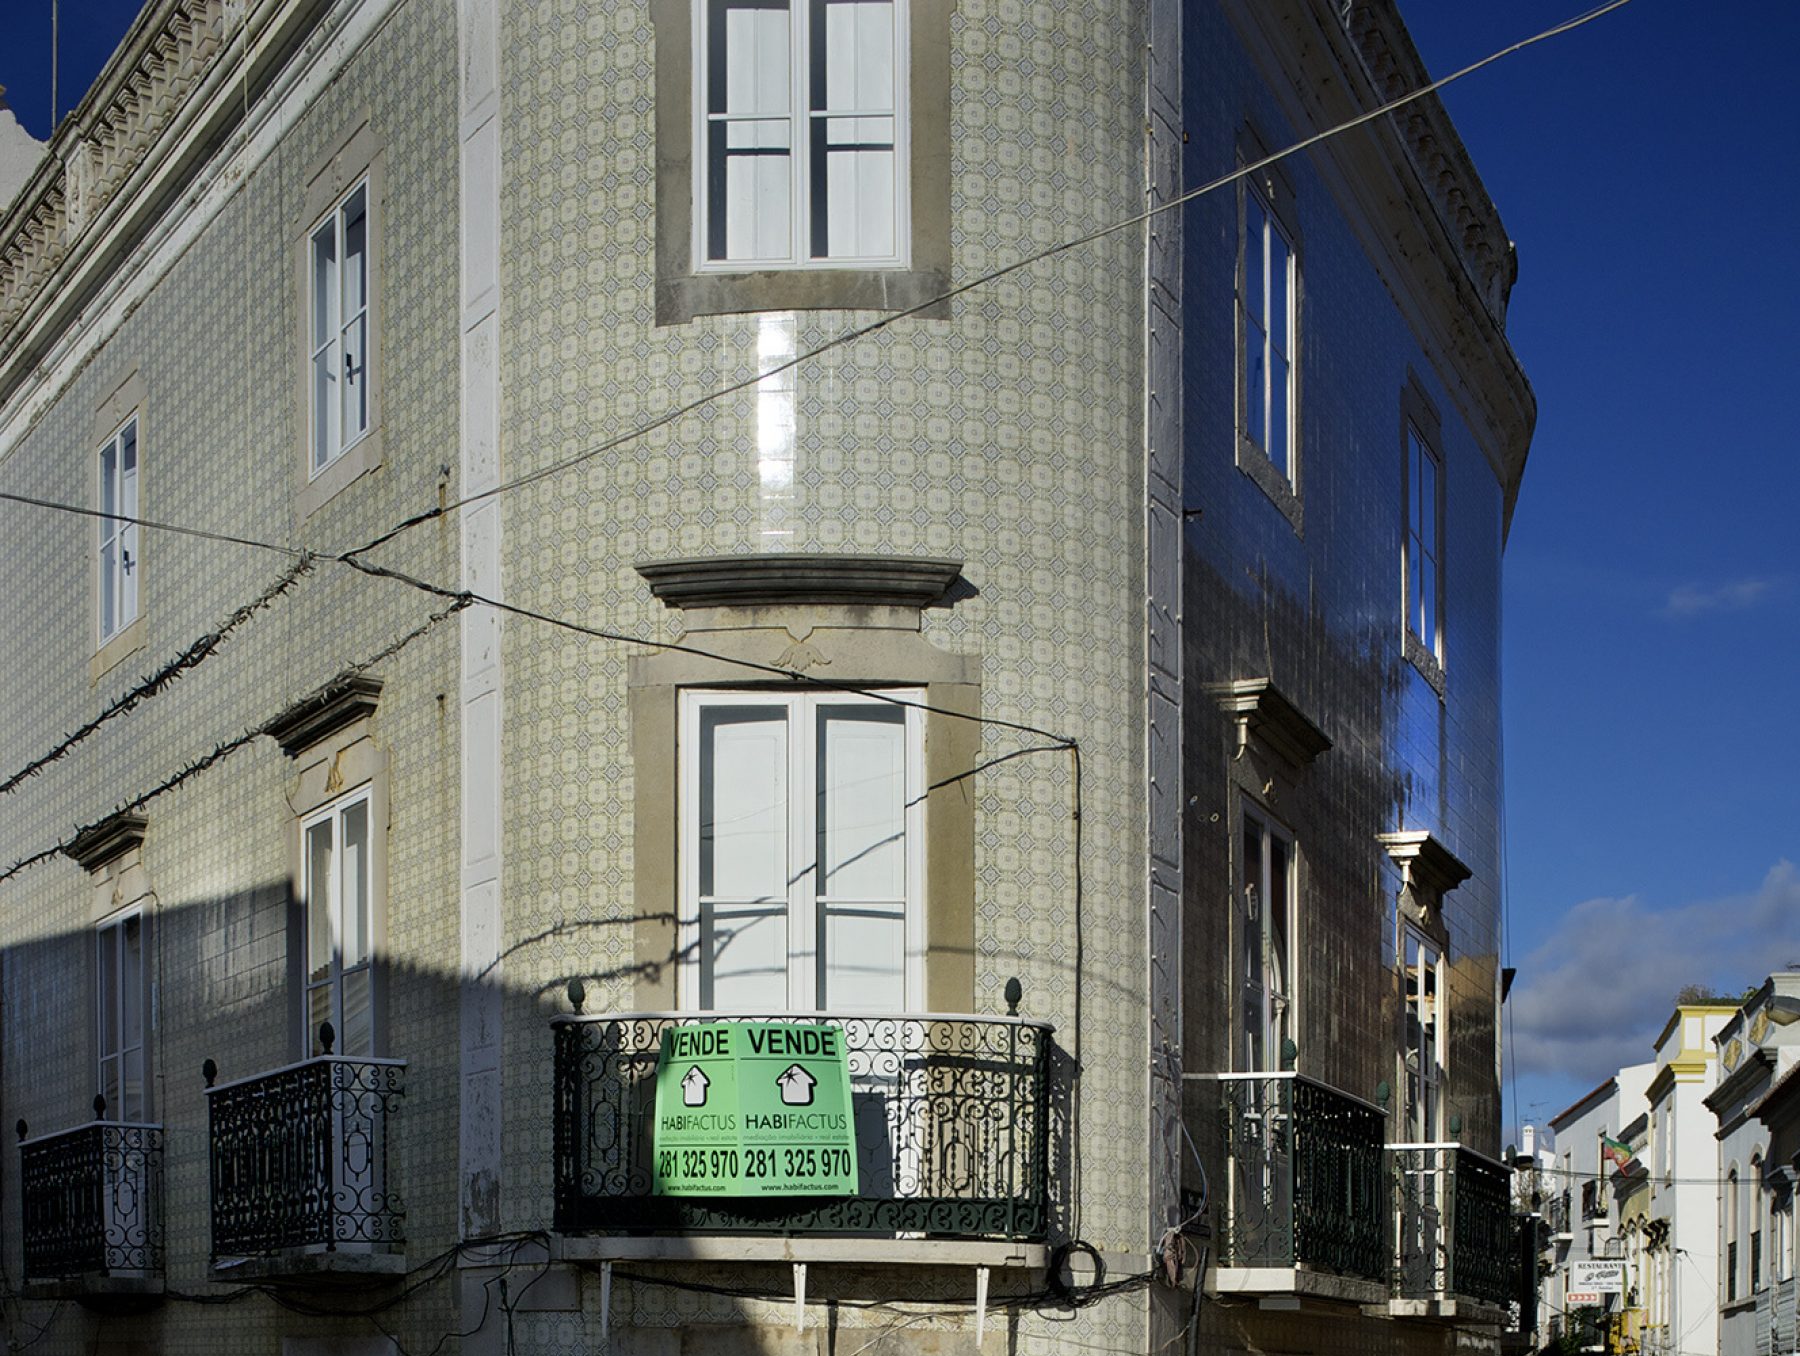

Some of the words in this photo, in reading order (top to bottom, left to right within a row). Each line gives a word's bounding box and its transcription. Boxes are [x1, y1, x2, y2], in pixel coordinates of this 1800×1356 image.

[670, 1029, 729, 1057] VENDE
[747, 1029, 836, 1056] VENDE
[661, 1114, 736, 1131] HABIFACTUS
[746, 1113, 847, 1130] HABIFACTUS
[659, 1150, 678, 1178] 281
[682, 1150, 707, 1178] 325
[711, 1149, 739, 1178] 970
[745, 1149, 777, 1177] 281
[784, 1149, 817, 1177] 325
[822, 1149, 851, 1177] 970
[667, 1184, 727, 1192] www.habifactus.com
[761, 1183, 839, 1192] www.habifactus.com
